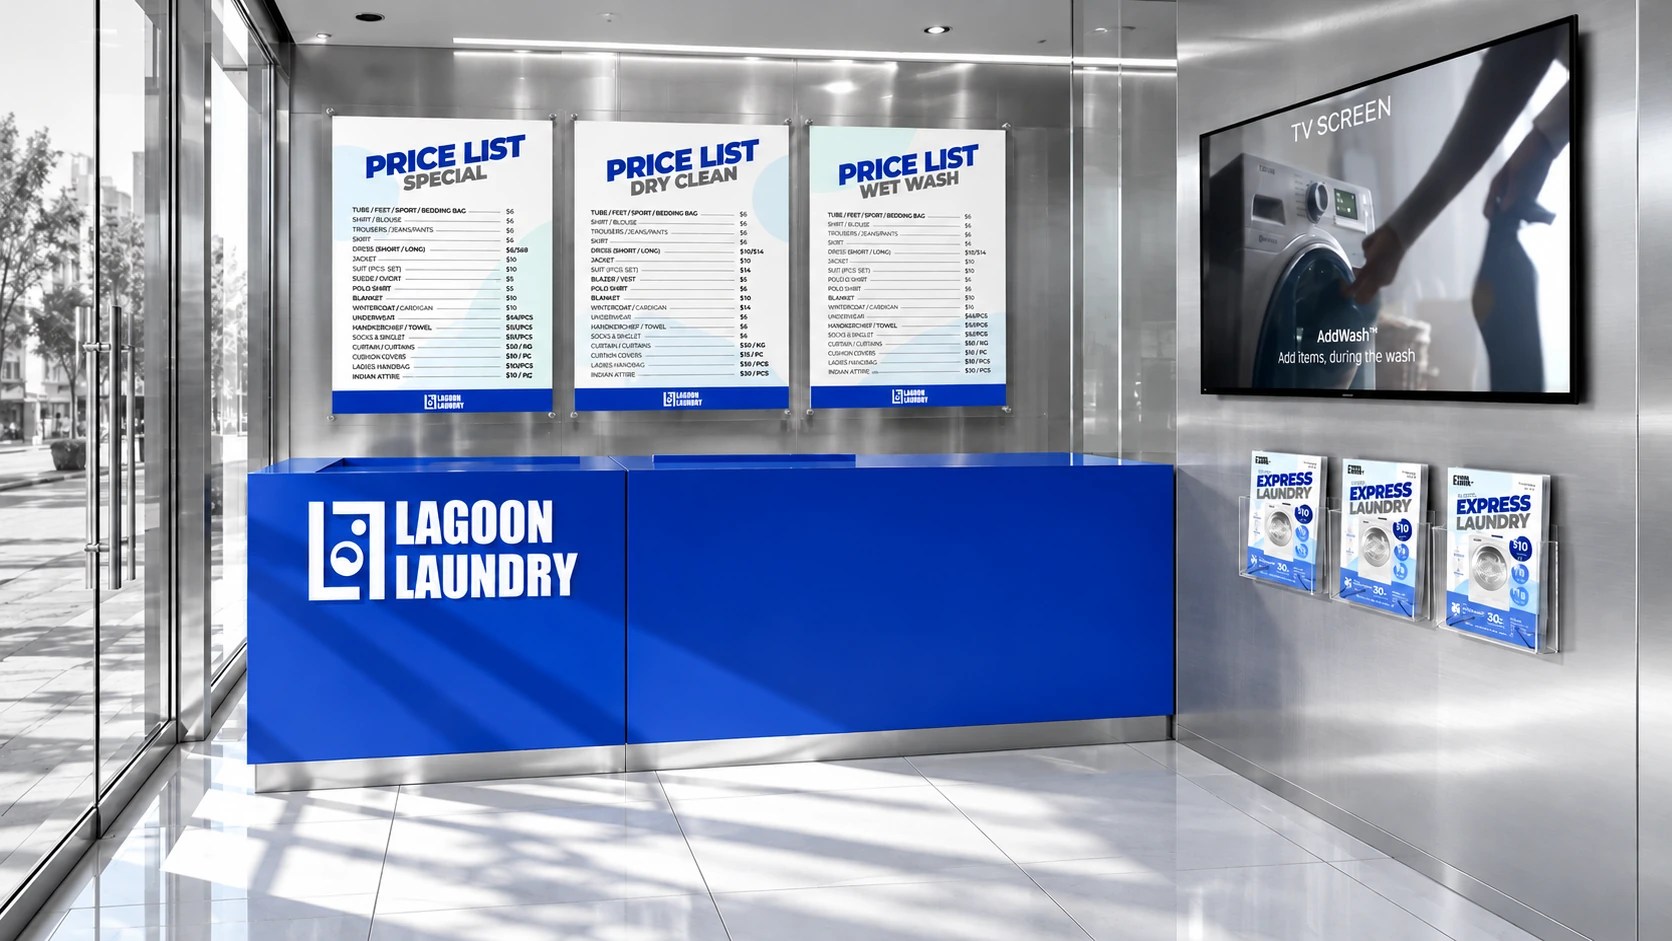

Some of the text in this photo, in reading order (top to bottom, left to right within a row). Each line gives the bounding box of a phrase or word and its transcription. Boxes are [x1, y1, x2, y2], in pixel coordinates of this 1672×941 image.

[1291, 95, 1390, 142] TV SCREEN
[366, 134, 526, 178] PRICE LIST
[607, 139, 759, 182] PRICE LIST
[839, 144, 979, 186] PRICE LIST
[403, 165, 487, 190] SPECIAL
[631, 166, 737, 196] DRY CLEAN
[860, 171, 959, 199] WET WASH
[1278, 348, 1415, 366] Add items, during the wash
[1257, 472, 1313, 487] EXPRESS
[1350, 482, 1412, 500] EXPRESS
[1257, 487, 1312, 500] LAUNDRY
[1457, 495, 1531, 514] EXPRESS
[1350, 499, 1412, 515] LAUNDRY
[396, 500, 553, 546] LAGOON
[1456, 513, 1530, 530] LAUNDRY
[1513, 539, 1527, 552] $10
[396, 553, 578, 600] LAUNDRY
